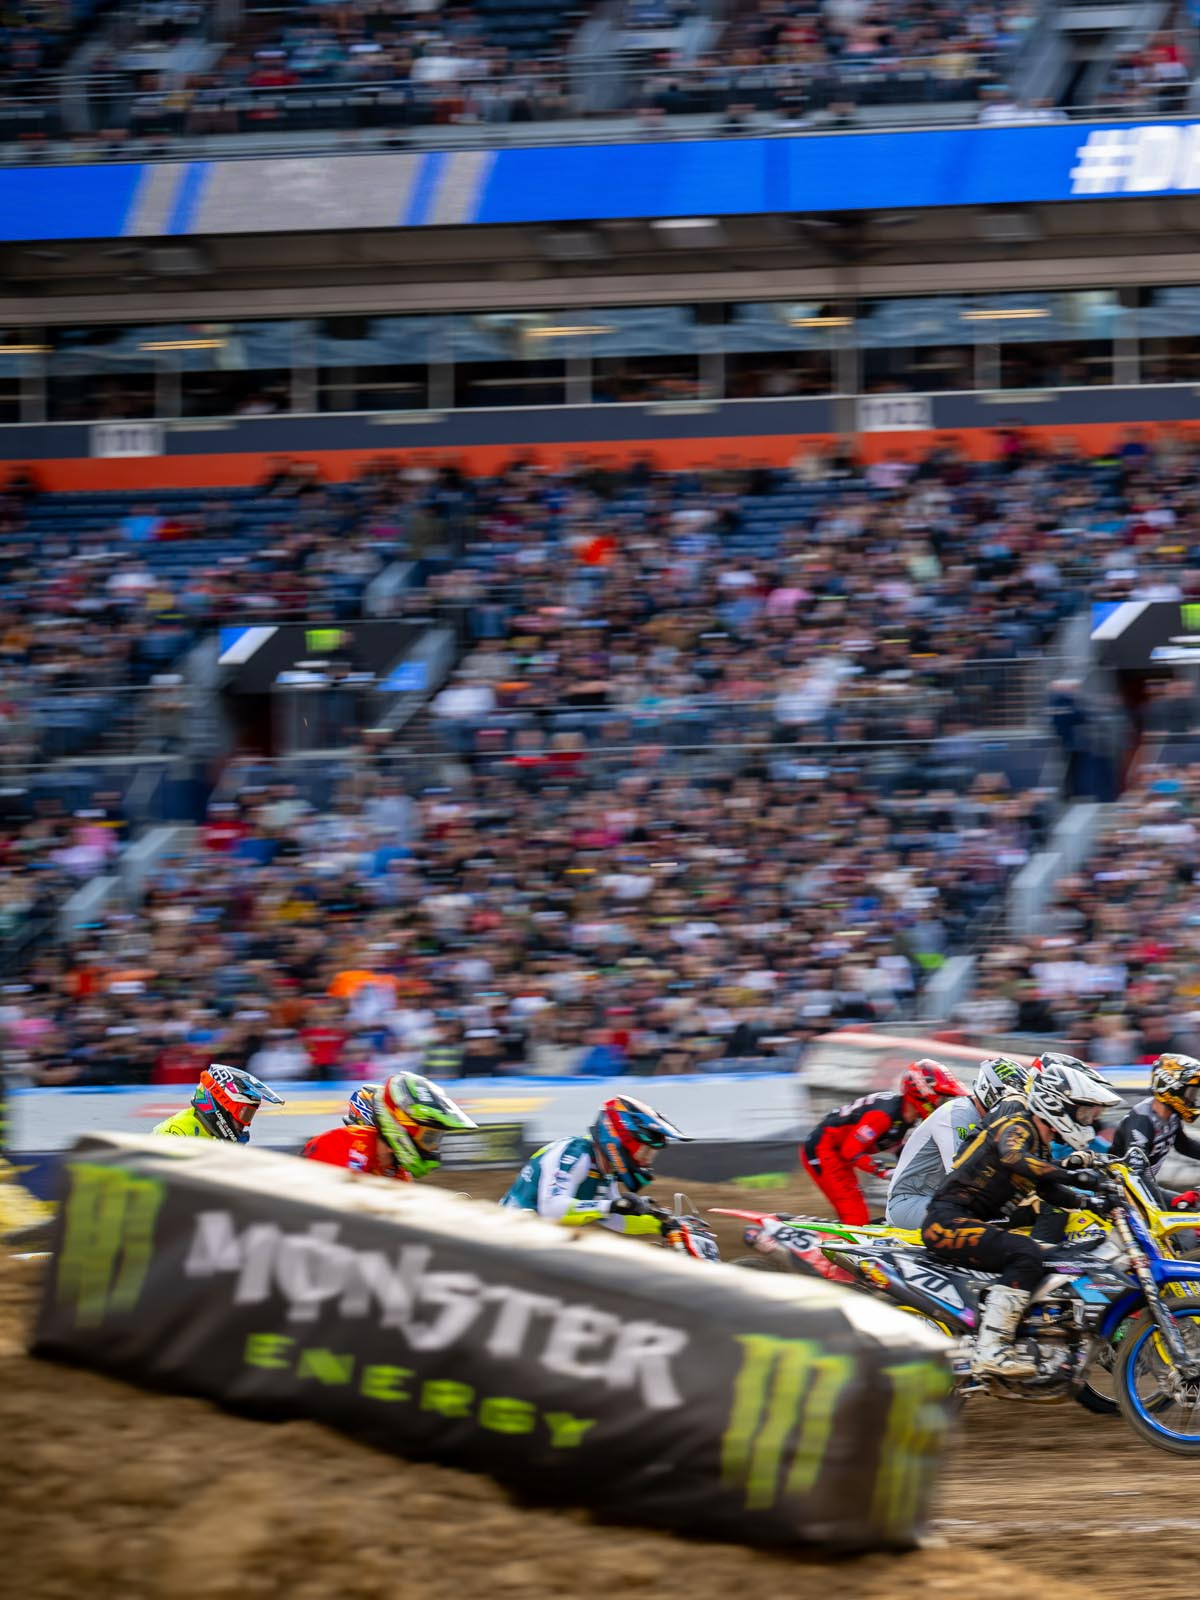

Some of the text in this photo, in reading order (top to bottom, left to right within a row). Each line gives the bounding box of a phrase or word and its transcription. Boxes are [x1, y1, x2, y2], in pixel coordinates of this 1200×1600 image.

[184, 1210, 688, 1409] MONSTER
[904, 1266, 950, 1294] 70
[245, 1333, 595, 1448] ENERGY
